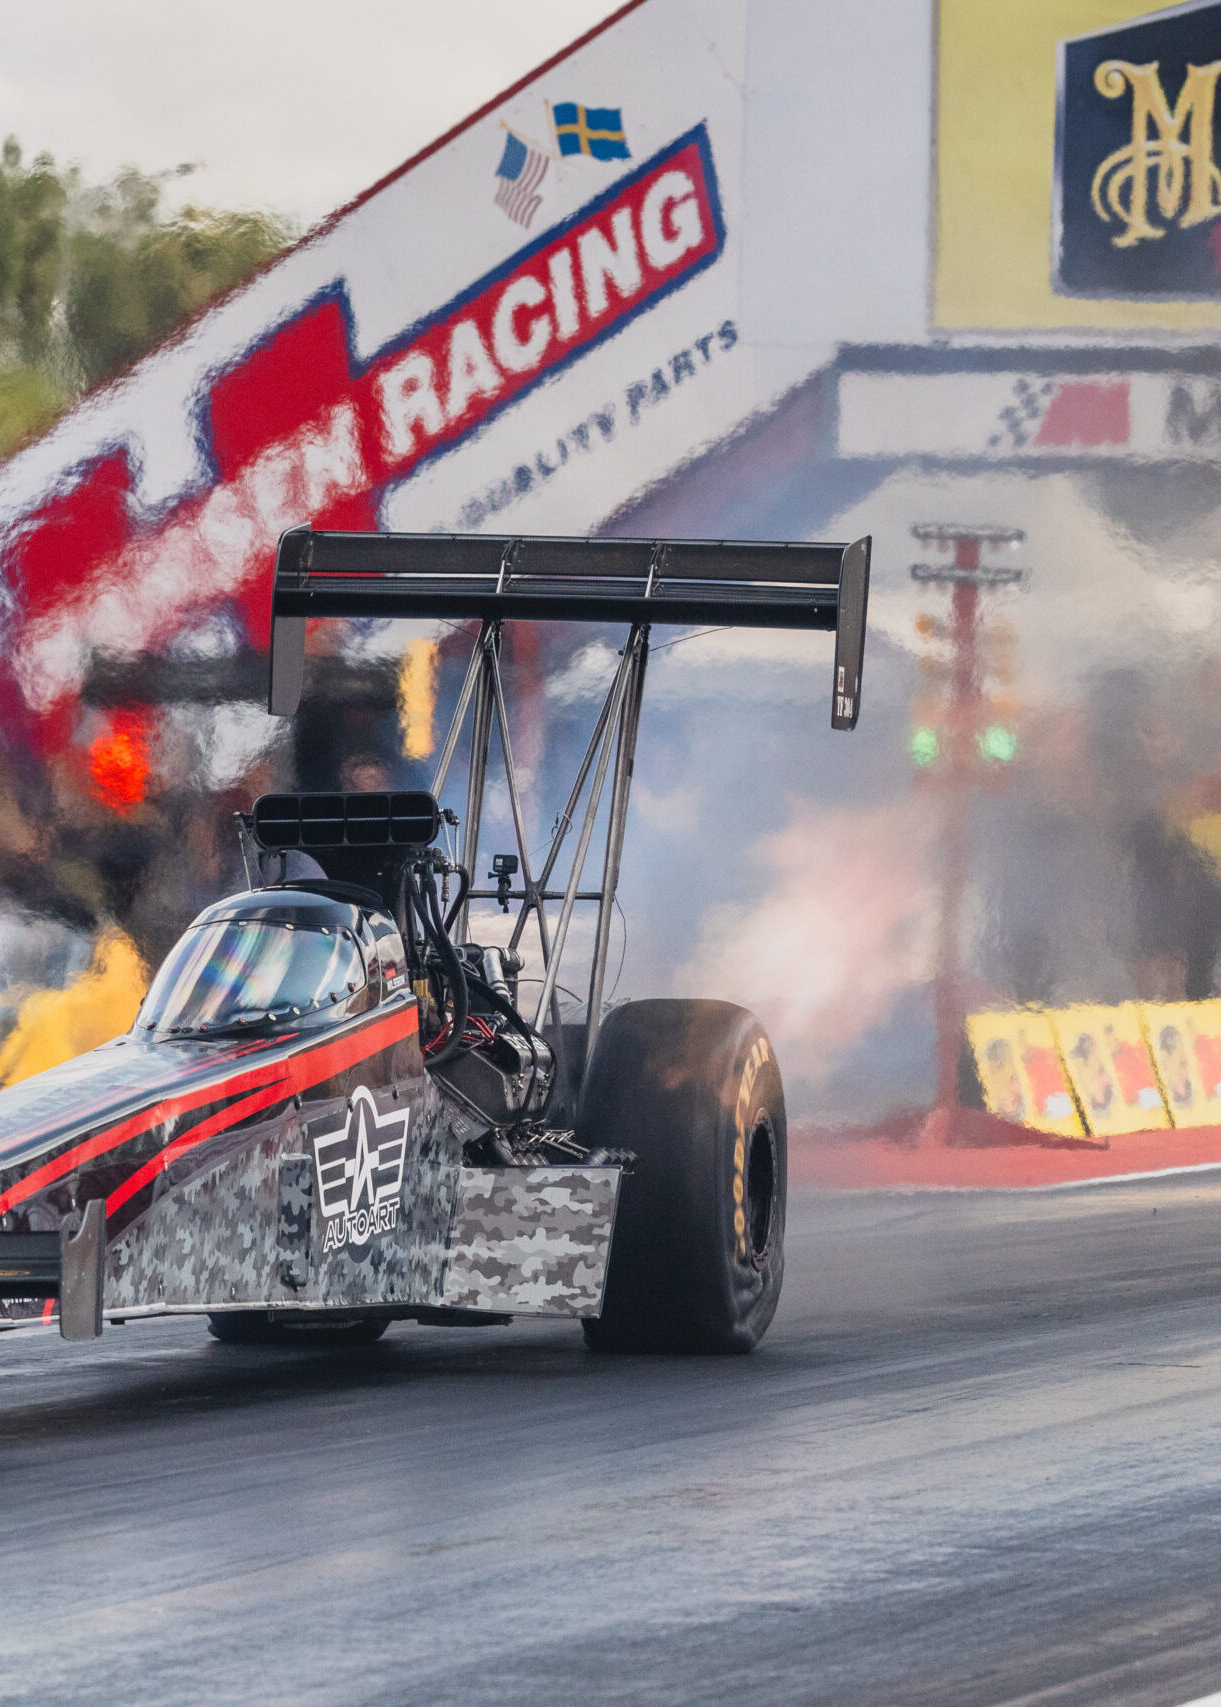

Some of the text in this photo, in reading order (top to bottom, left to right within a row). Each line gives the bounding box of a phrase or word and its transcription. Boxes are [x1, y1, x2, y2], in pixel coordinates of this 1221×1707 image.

[378, 170, 705, 461] RACING
[455, 319, 738, 530] ALITY PARTS
[323, 1196, 401, 1254] AUTOART
